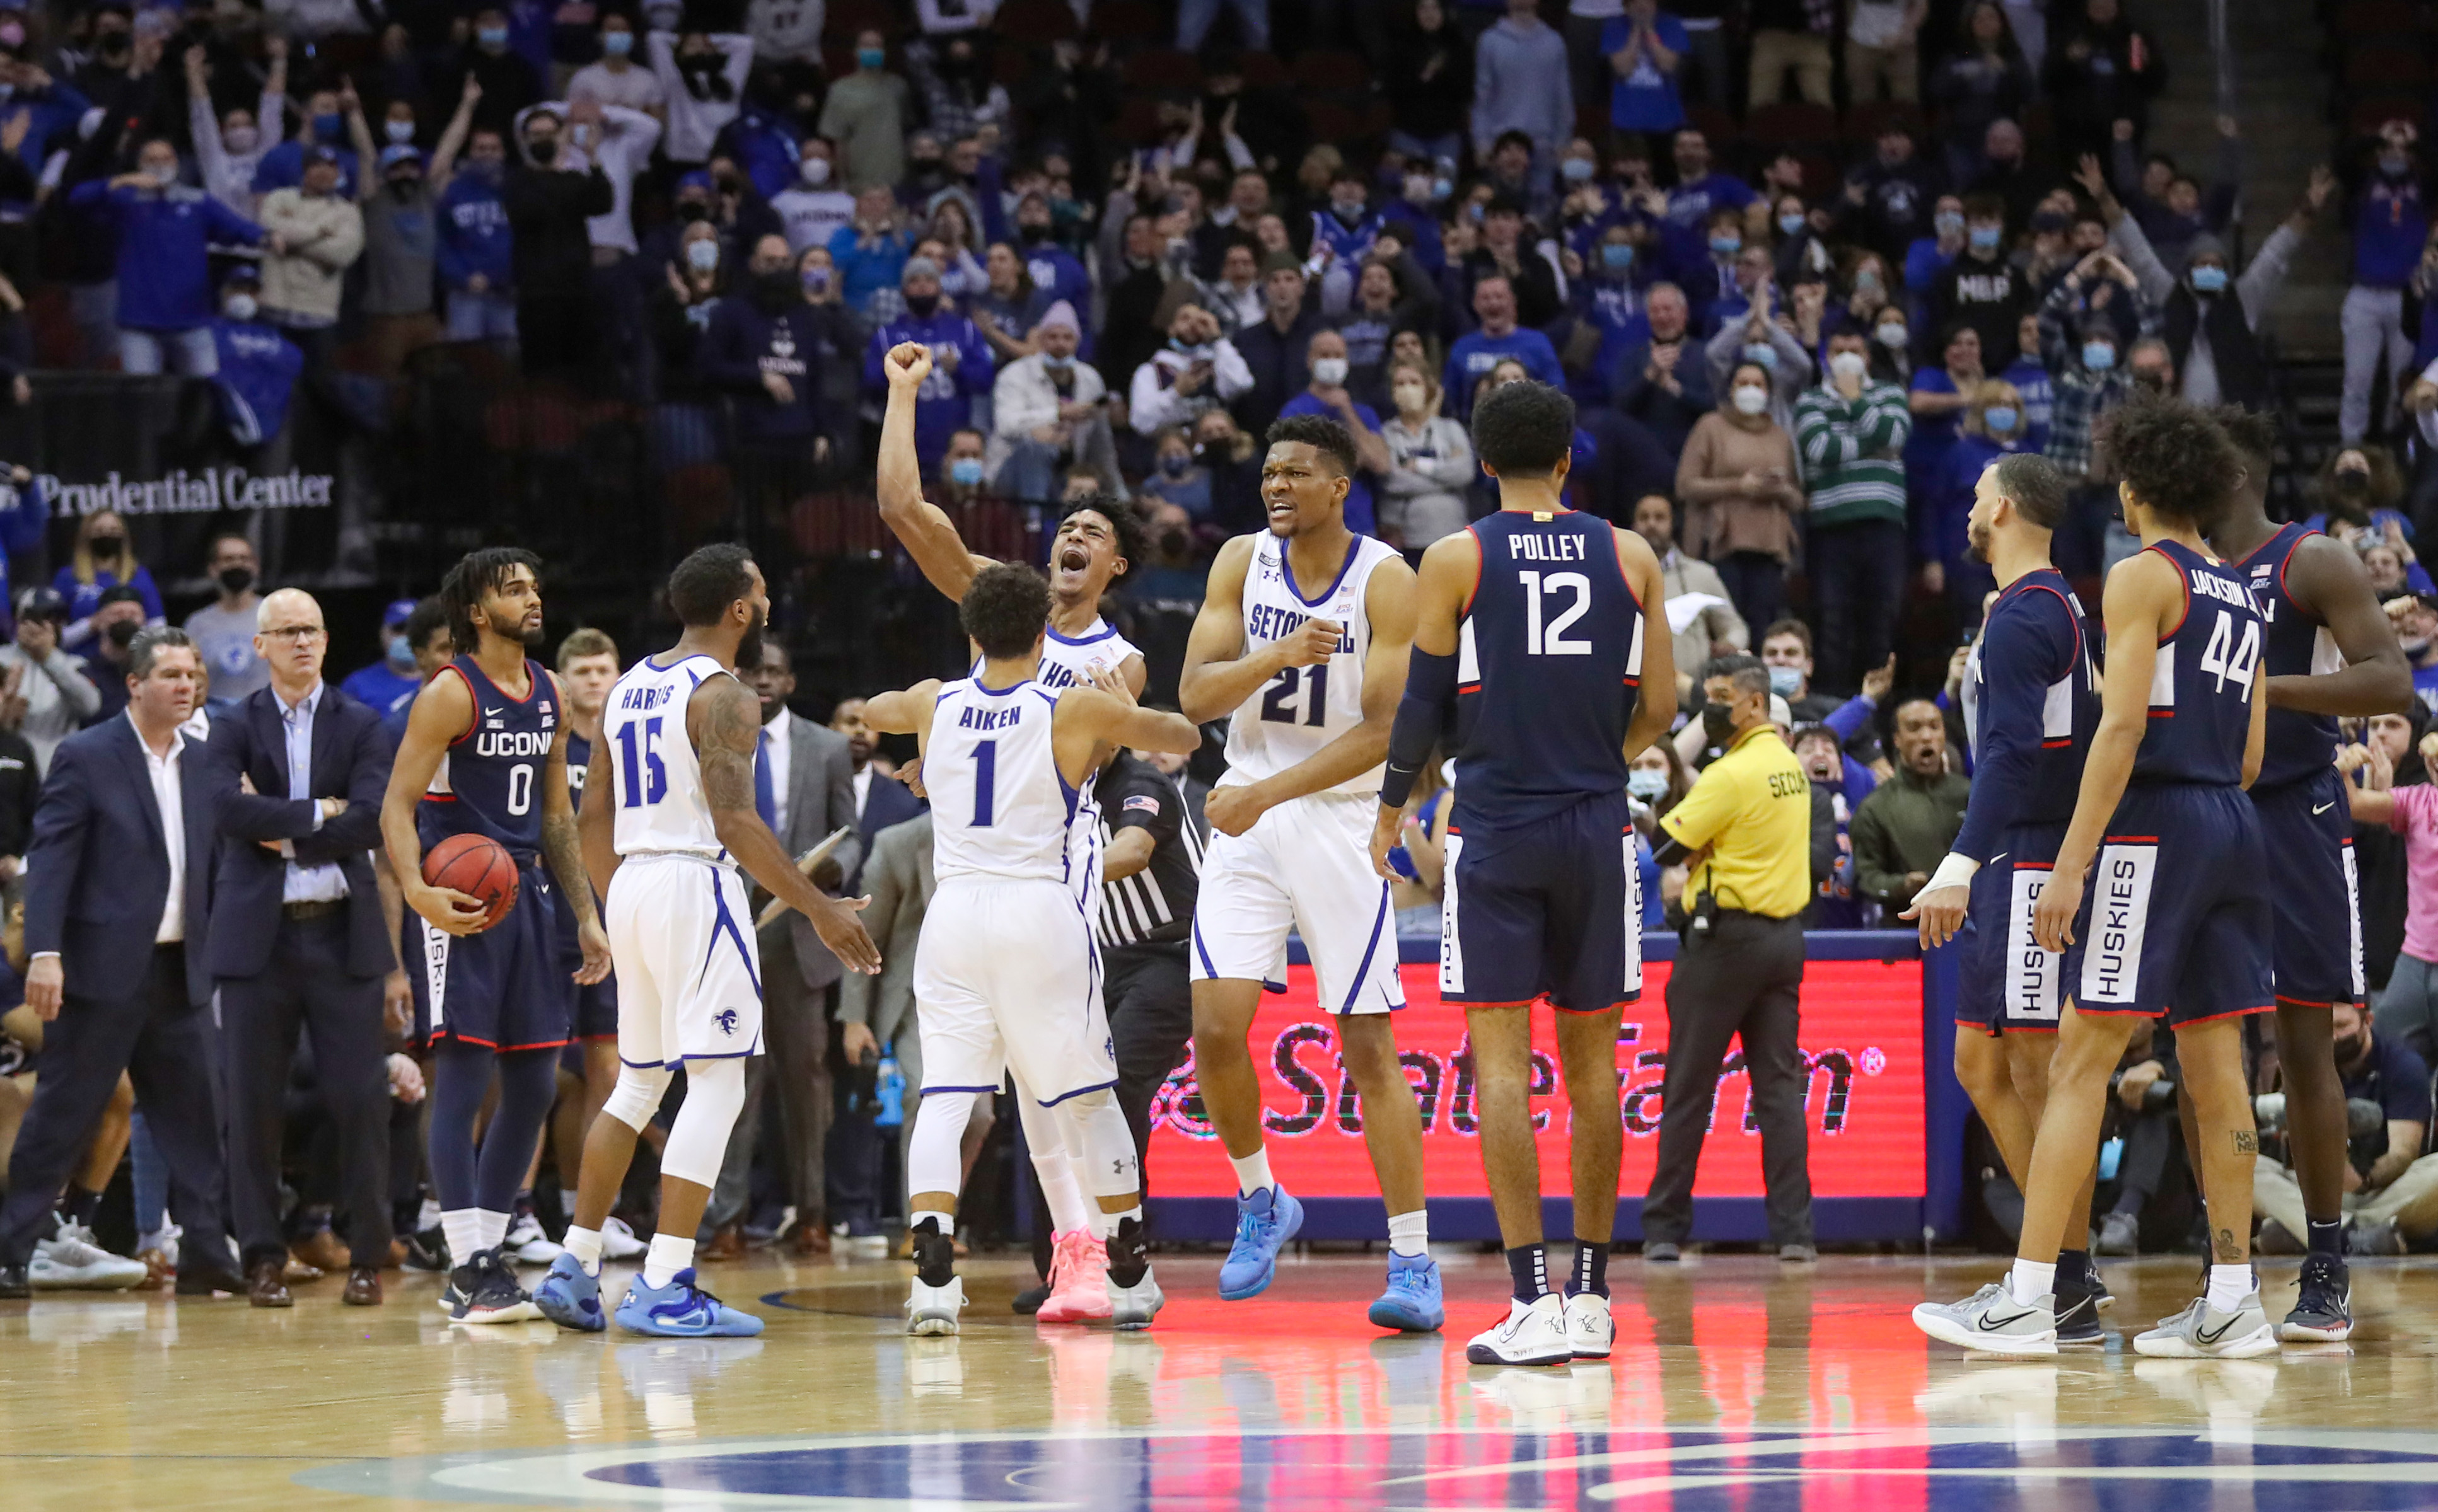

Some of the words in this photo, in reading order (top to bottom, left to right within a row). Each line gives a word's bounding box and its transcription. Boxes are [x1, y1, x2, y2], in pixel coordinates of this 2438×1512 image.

[39, 470, 221, 517] Prudential
[224, 466, 333, 511] Center
[1508, 534, 1585, 561] POLLEY
[1519, 570, 1592, 655] 12
[2190, 568, 2248, 608] JACKSON
[2200, 610, 2260, 703] 44
[958, 705, 1021, 730] AIKEN
[1260, 665, 1328, 728] 21
[508, 763, 534, 816] 0
[615, 716, 668, 809] 15
[966, 739, 997, 829] 1
[2098, 860, 2135, 996] HUSKIES
